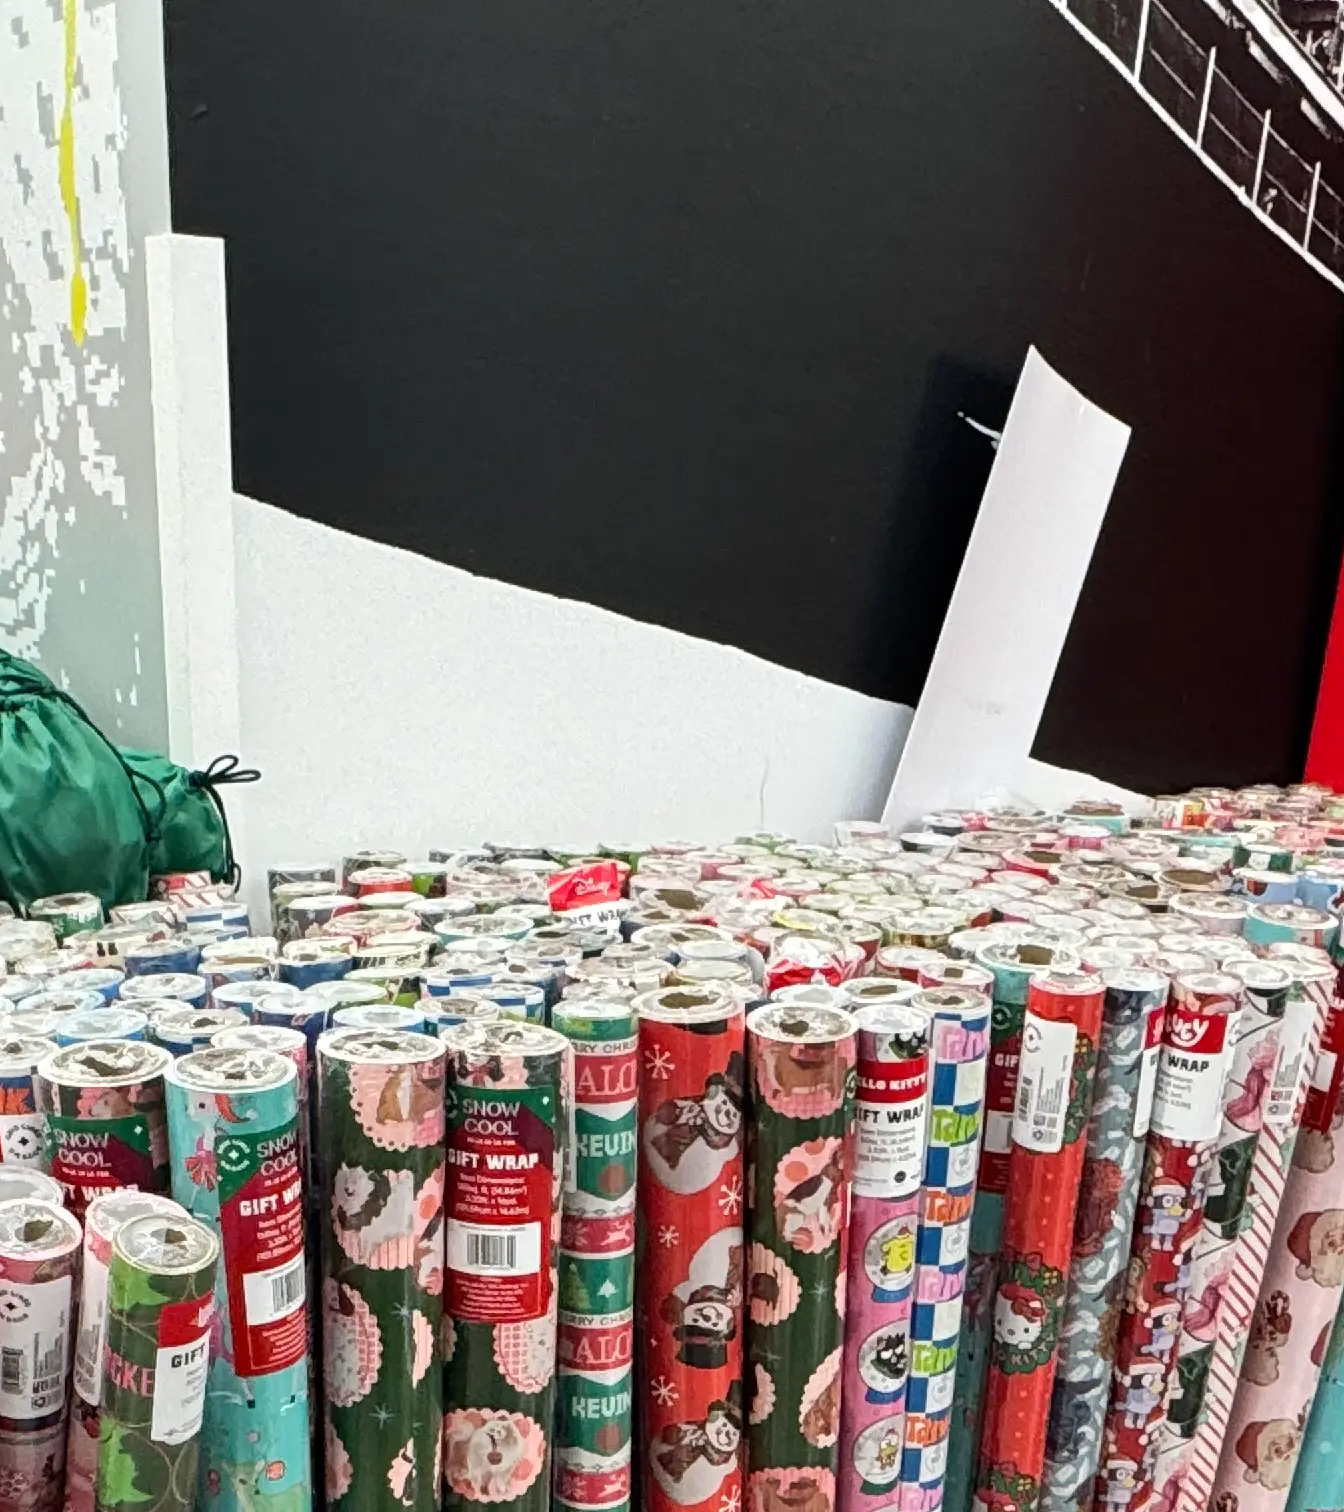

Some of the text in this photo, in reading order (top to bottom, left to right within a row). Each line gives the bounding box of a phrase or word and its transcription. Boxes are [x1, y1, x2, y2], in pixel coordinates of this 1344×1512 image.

[1167, 1055, 1211, 1073] WRAP
[577, 1062, 637, 1096] ALO
[460, 1101, 521, 1118] SNOW
[462, 1117, 520, 1136] COOL
[58, 1129, 109, 1149] SNOW
[58, 1150, 113, 1169] COOL
[448, 1148, 540, 1171] GIFT WRAP
[239, 1195, 279, 1217] GIFT
[572, 1327, 632, 1365] ALO
